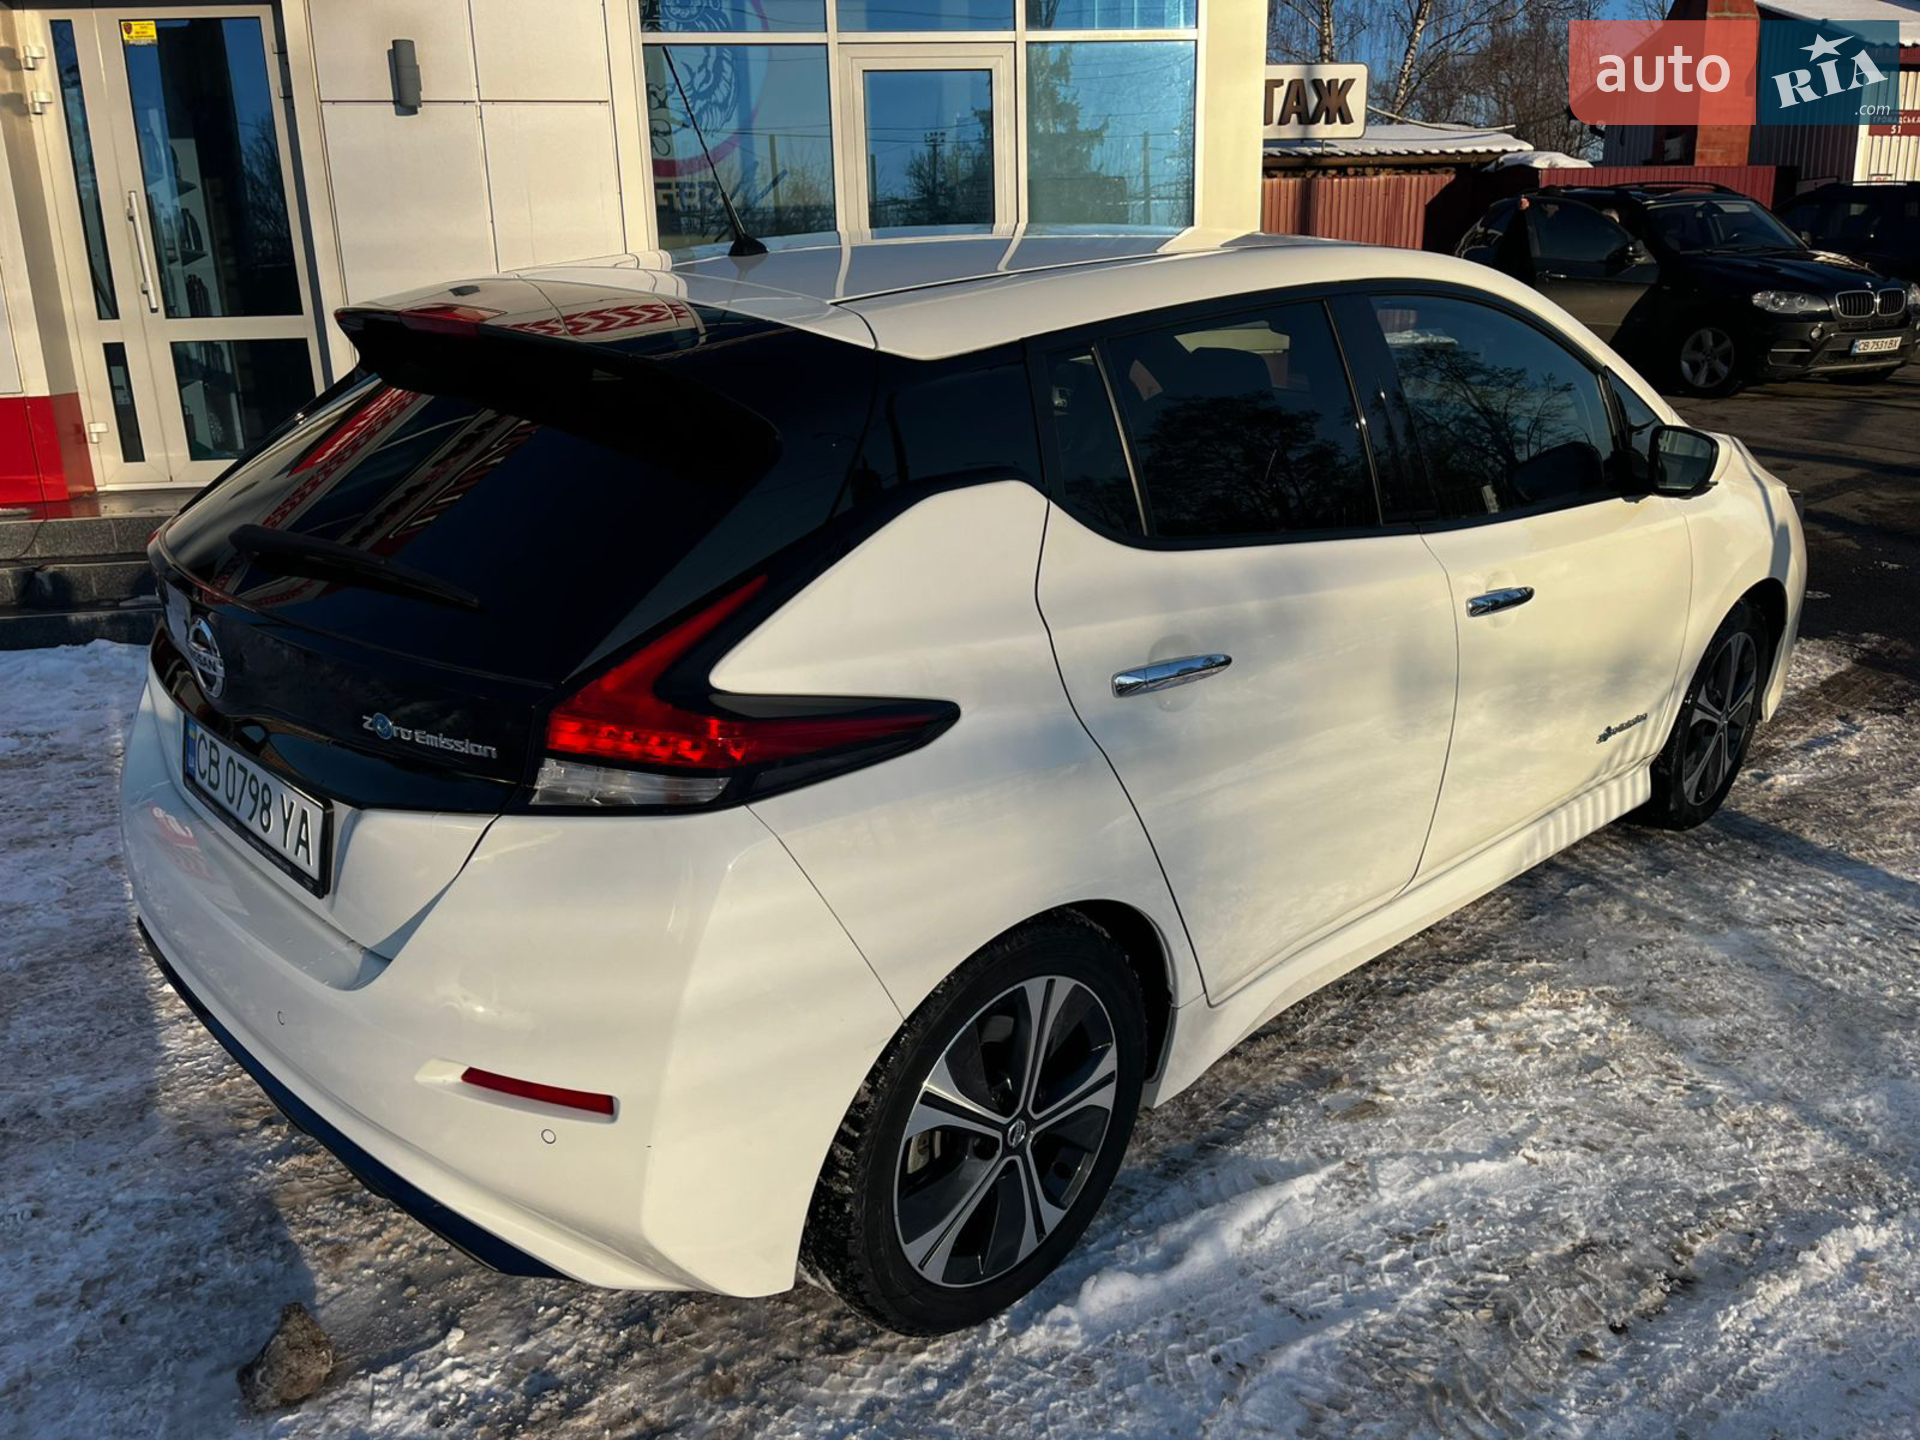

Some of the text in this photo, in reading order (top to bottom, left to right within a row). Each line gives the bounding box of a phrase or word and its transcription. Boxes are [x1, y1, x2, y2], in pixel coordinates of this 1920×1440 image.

[1890, 125, 1902, 134] 51
[414, 729, 497, 759] Emission
[197, 733, 220, 792] CB
[225, 756, 273, 834] 0798
[281, 792, 313, 867] YA
